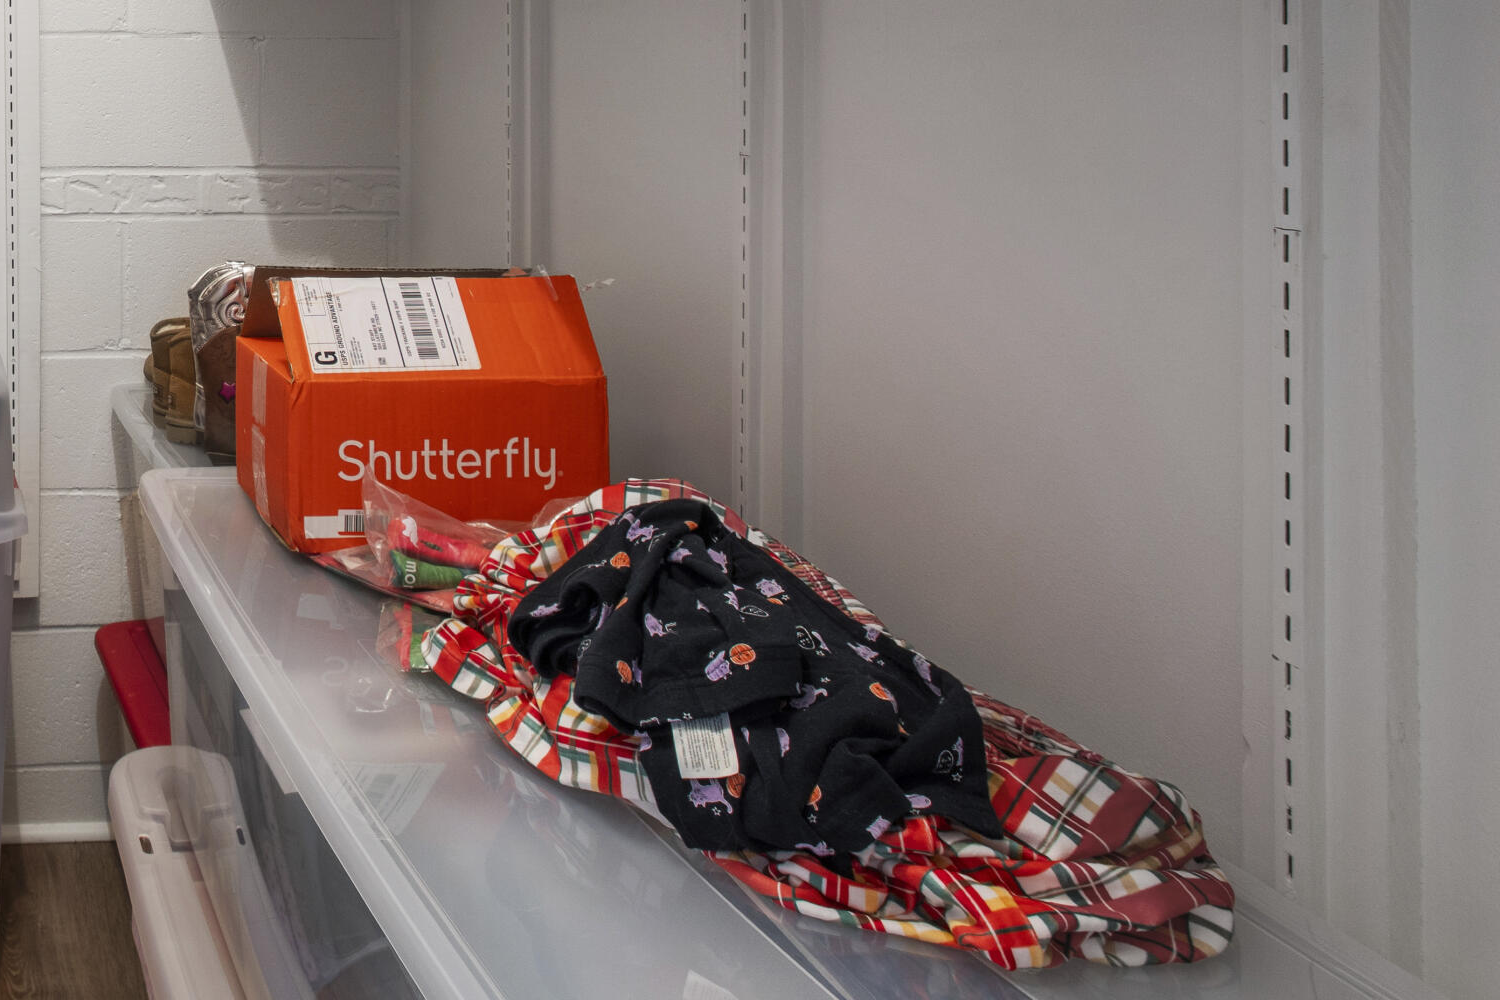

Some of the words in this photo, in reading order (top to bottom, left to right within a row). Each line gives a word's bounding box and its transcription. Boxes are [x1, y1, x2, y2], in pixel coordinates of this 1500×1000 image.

[325, 292, 338, 324] ADVANTAGE
[333, 325, 345, 348] GROUND
[314, 351, 338, 365] G
[339, 350, 349, 366] USPS
[338, 437, 557, 491] Shutterfly
